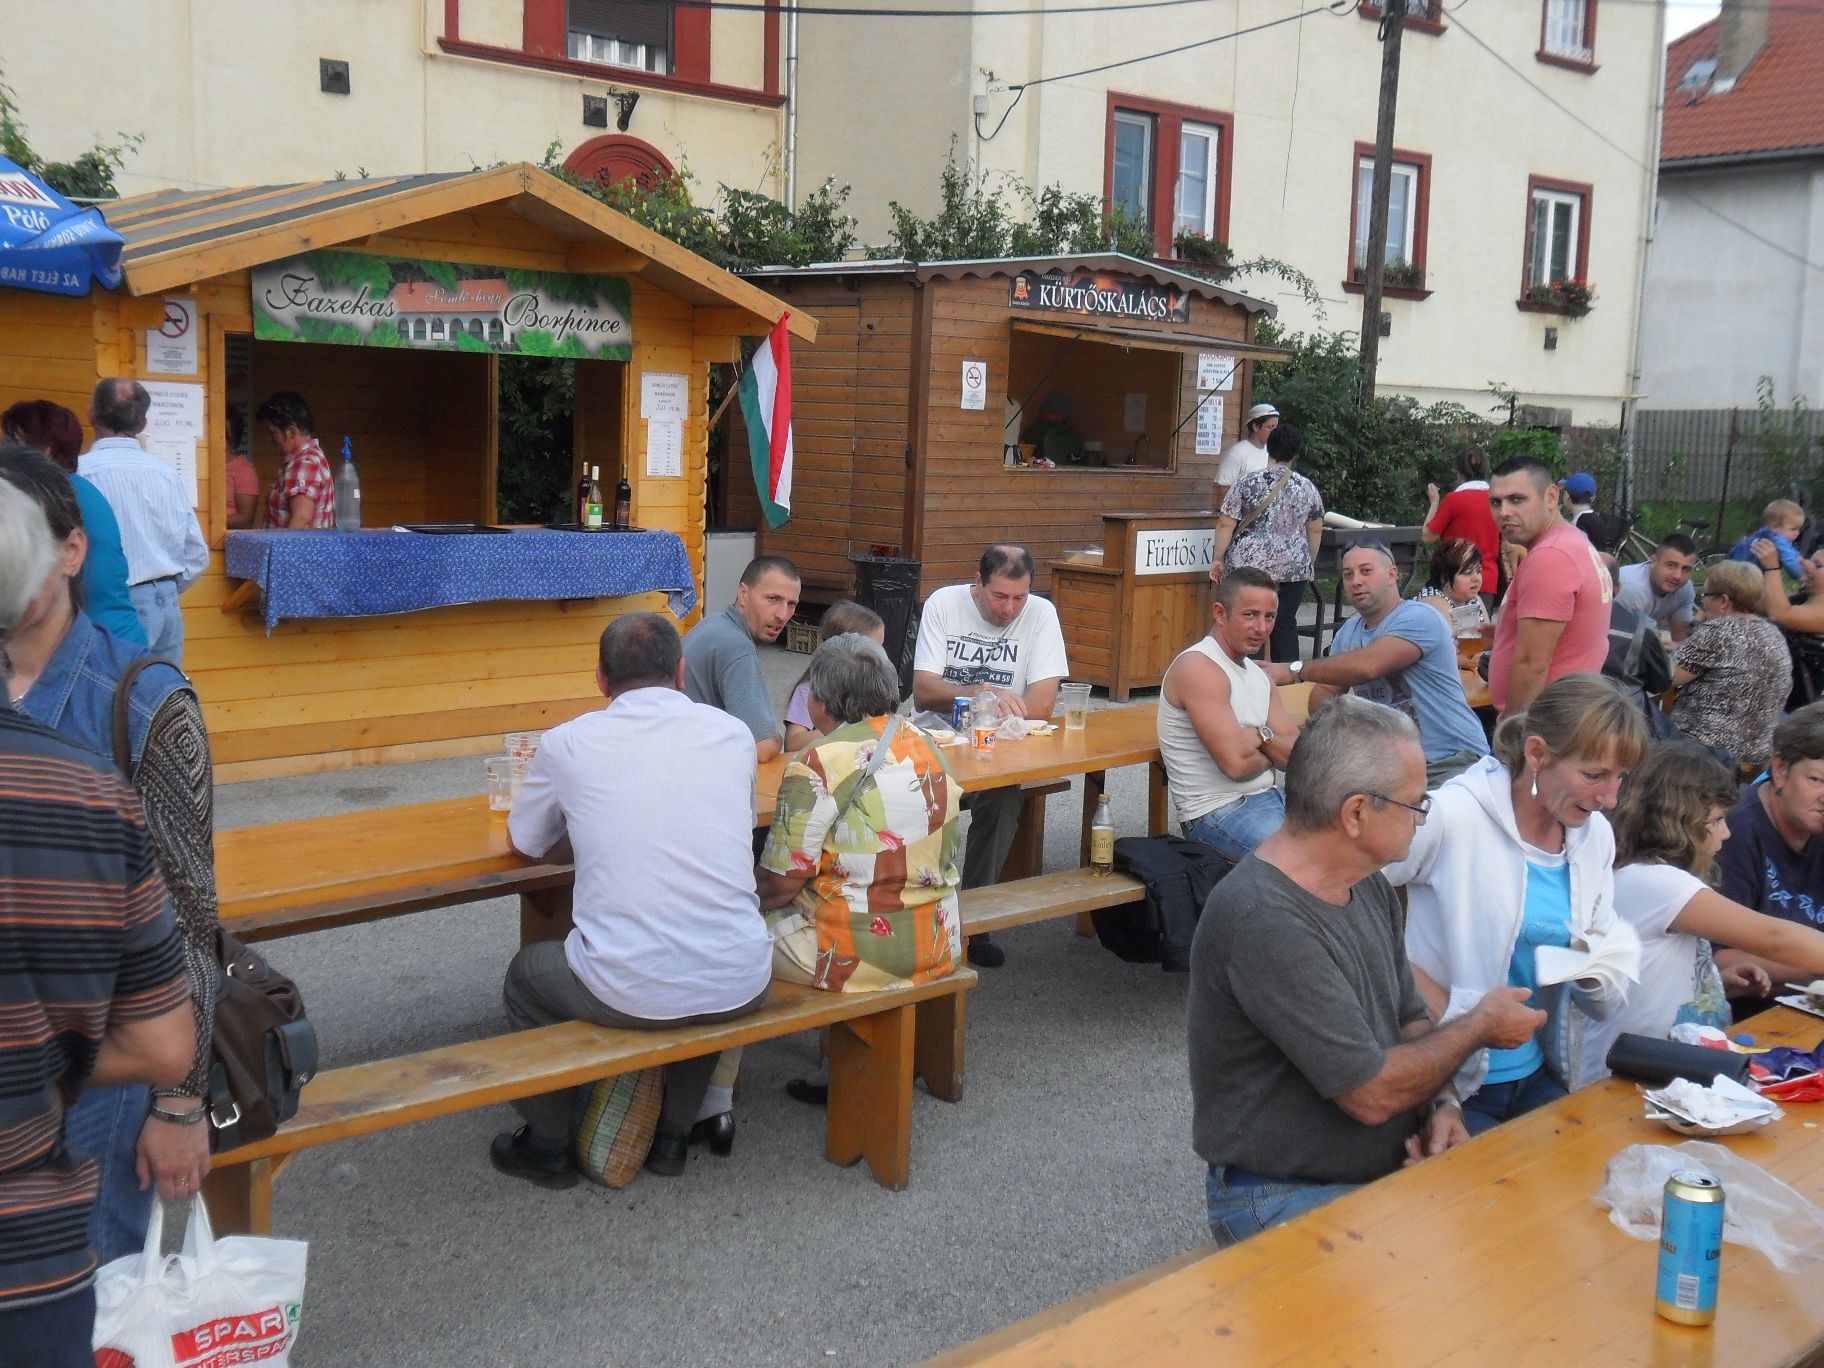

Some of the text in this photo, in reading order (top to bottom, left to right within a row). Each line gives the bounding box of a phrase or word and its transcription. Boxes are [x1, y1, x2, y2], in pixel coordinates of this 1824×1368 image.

[265, 273, 396, 318] Fazekas
[503, 293, 621, 340] Borpince
[1039, 281, 1167, 319] KÜRTŐSKALÁCS
[1145, 537, 1196, 567] Fürtös
[195, 1313, 282, 1351] SPAR
